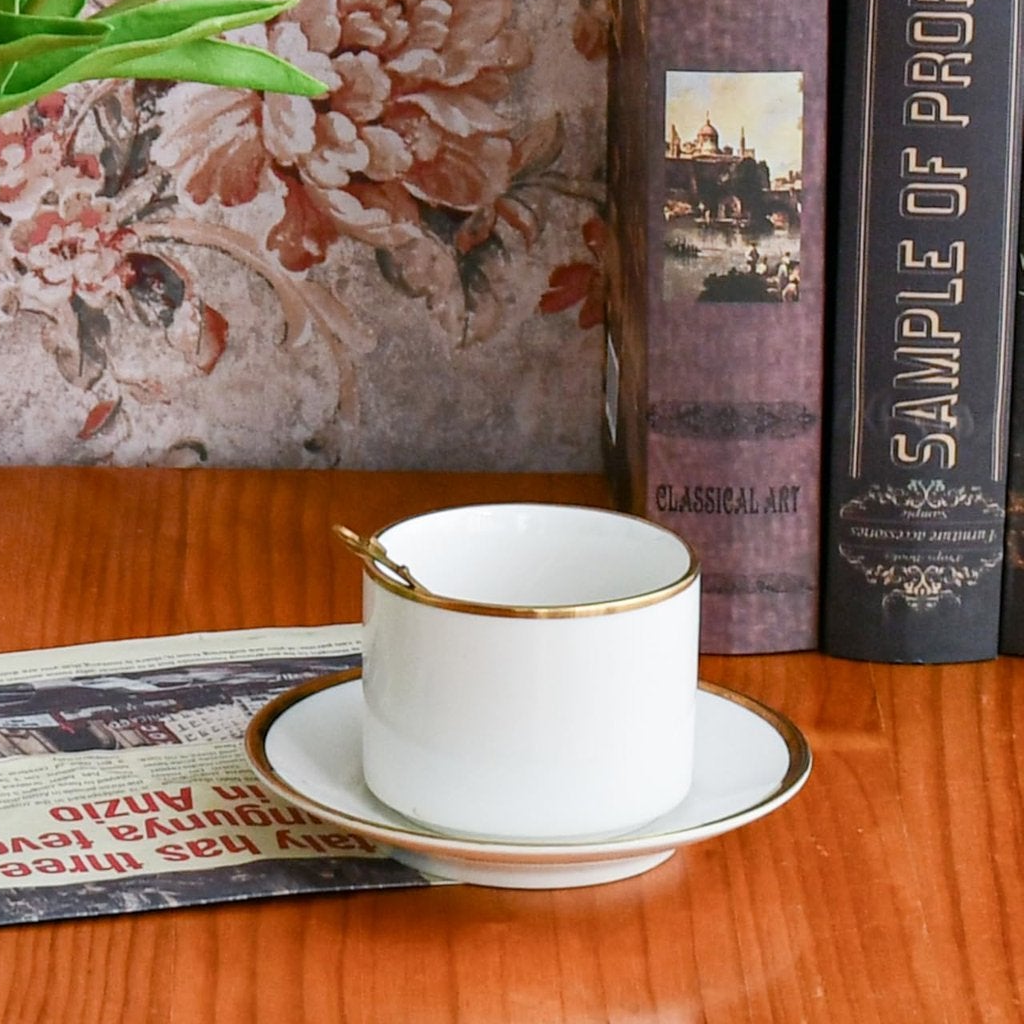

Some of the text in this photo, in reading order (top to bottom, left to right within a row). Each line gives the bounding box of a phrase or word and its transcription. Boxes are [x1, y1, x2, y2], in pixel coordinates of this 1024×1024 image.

[899, 146, 970, 221] OF
[890, 239, 966, 470] SAMPLE
[655, 483, 801, 515] CLASSICAL ART
[50, 783, 271, 822] in Anzio
[162, 834, 263, 863] has
[274, 828, 378, 855] taly
[1, 849, 146, 878] three
